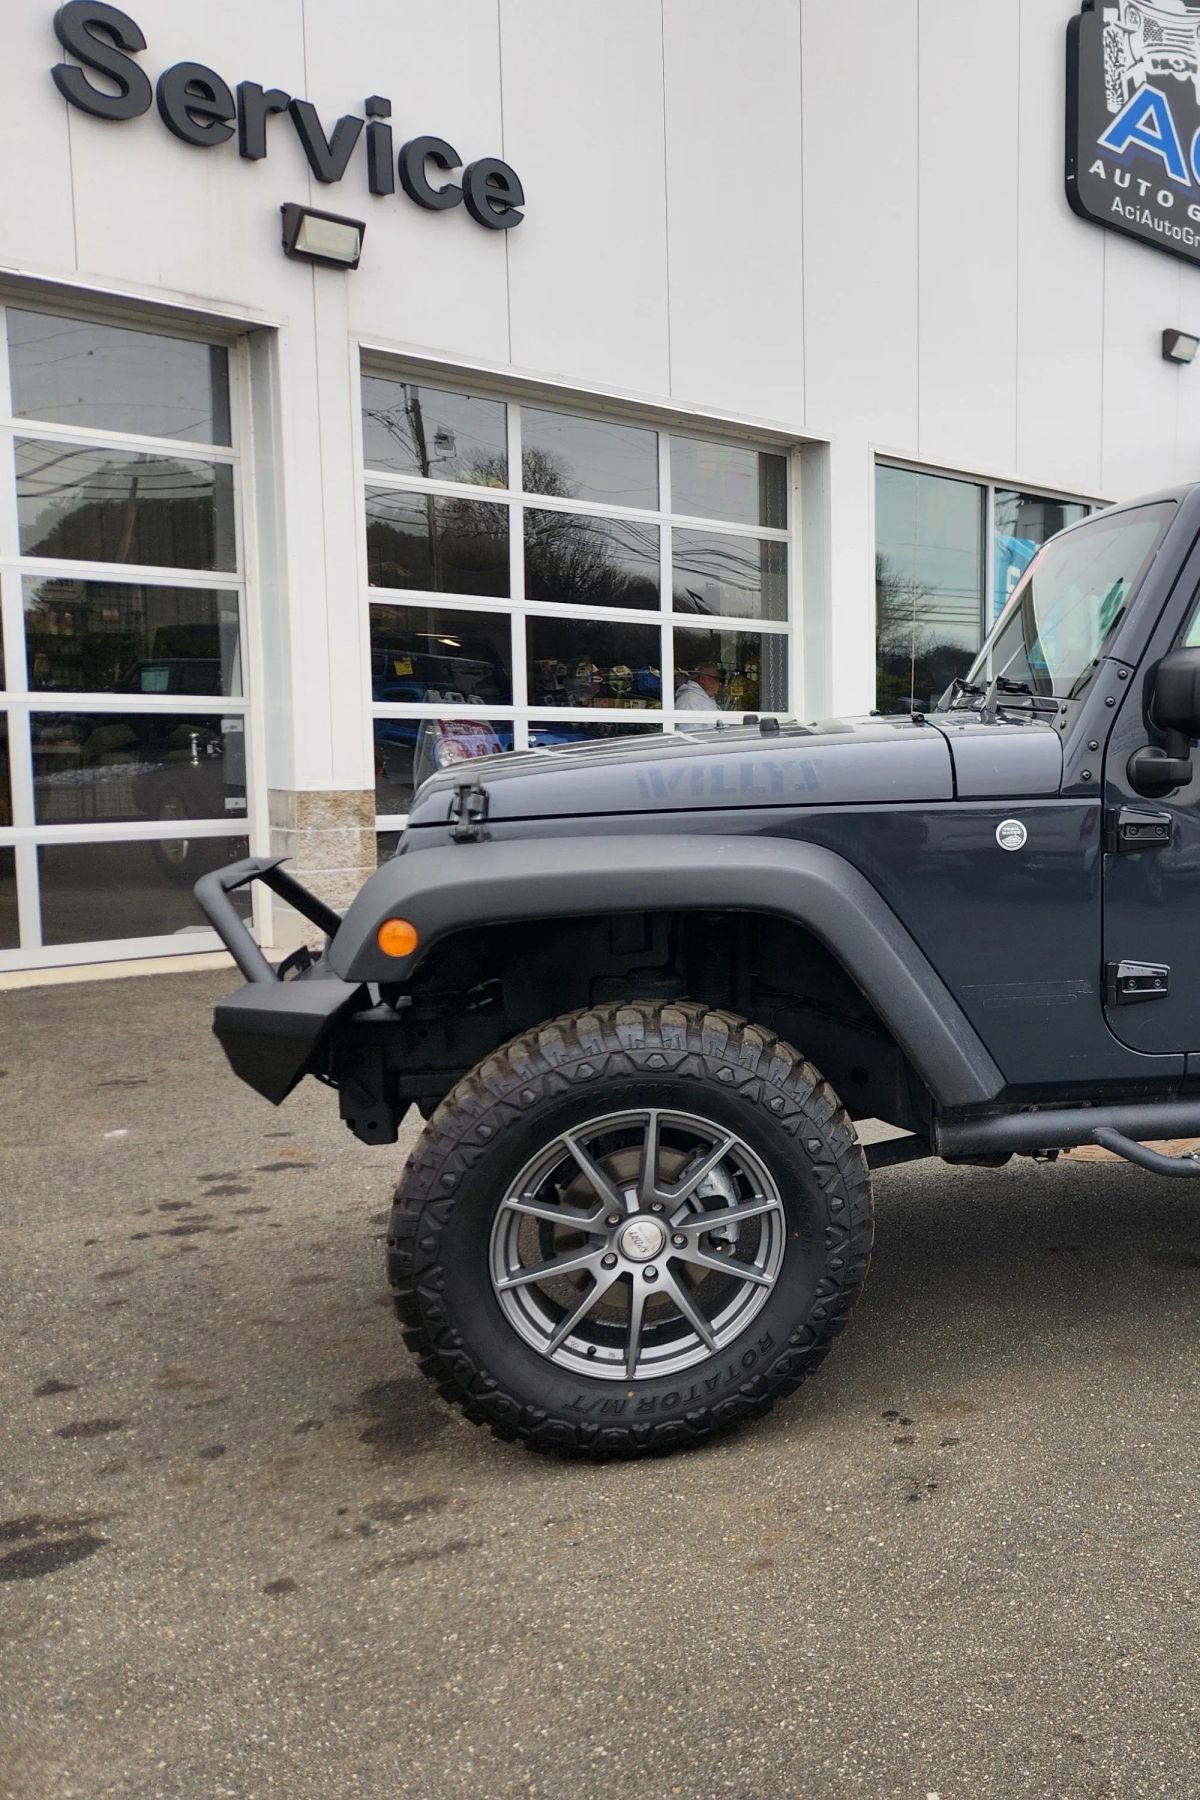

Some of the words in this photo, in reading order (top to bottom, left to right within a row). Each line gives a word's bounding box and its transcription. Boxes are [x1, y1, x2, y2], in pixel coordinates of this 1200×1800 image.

[50, 0, 526, 230] Service
[1088, 159, 1174, 208] AUTO
[634, 758, 823, 799] WILLYS
[636, 1329, 777, 1416] ROTATOR
